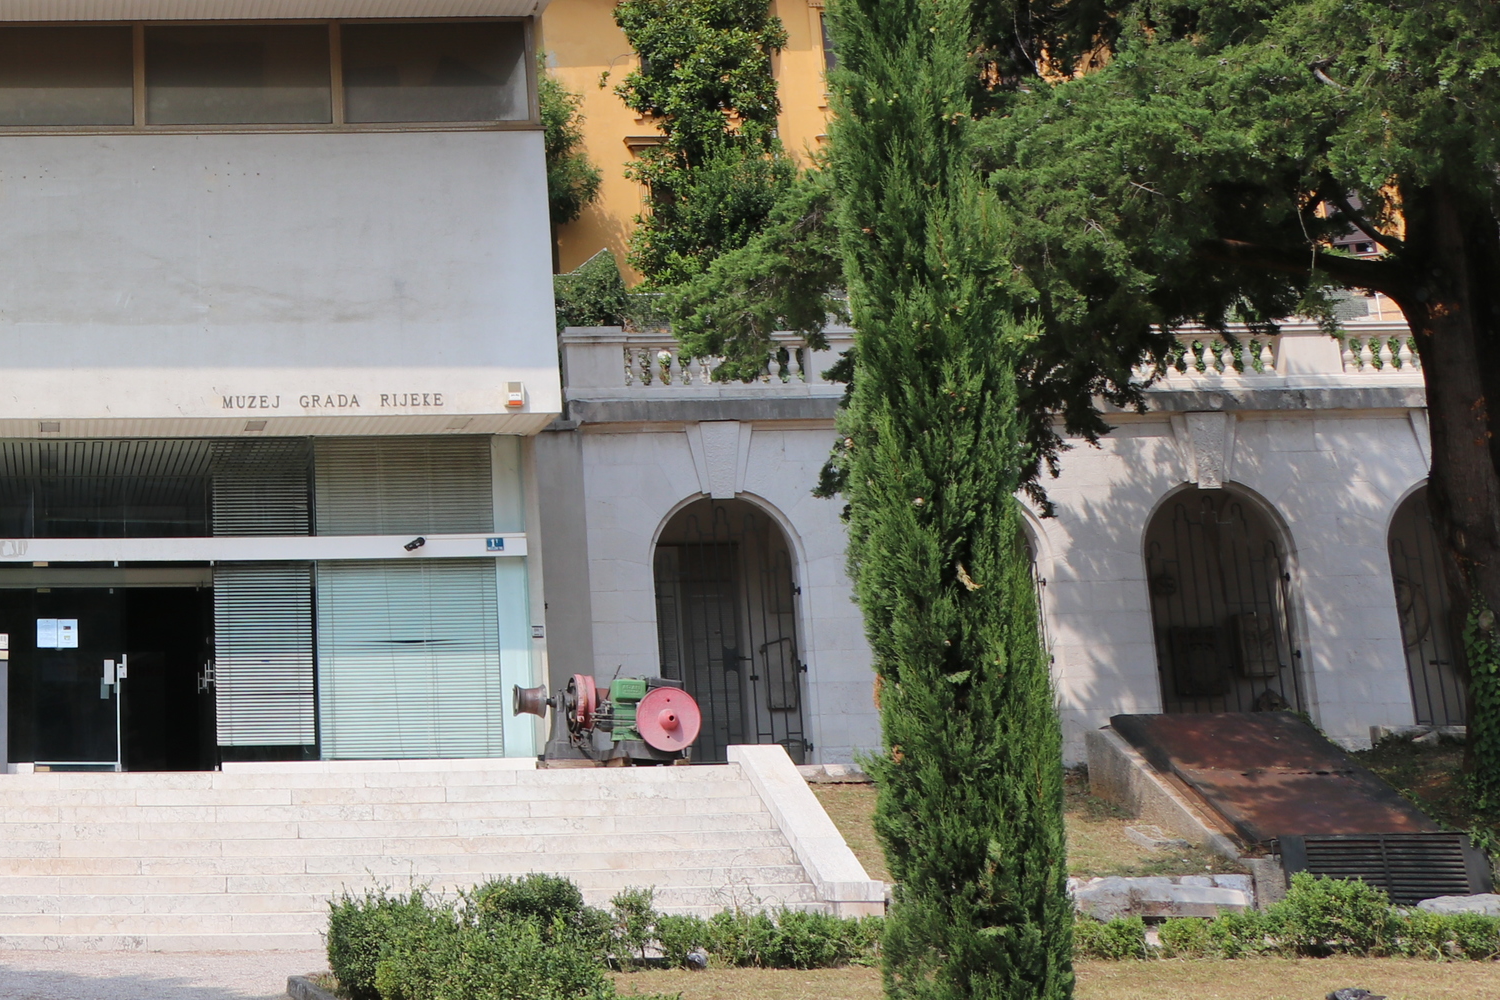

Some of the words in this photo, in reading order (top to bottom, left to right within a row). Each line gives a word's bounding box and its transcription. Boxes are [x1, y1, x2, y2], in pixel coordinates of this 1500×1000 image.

[222, 395, 280, 408] MUZEJ
[299, 394, 360, 408] GRADA
[380, 393, 444, 407] RIJEKE
